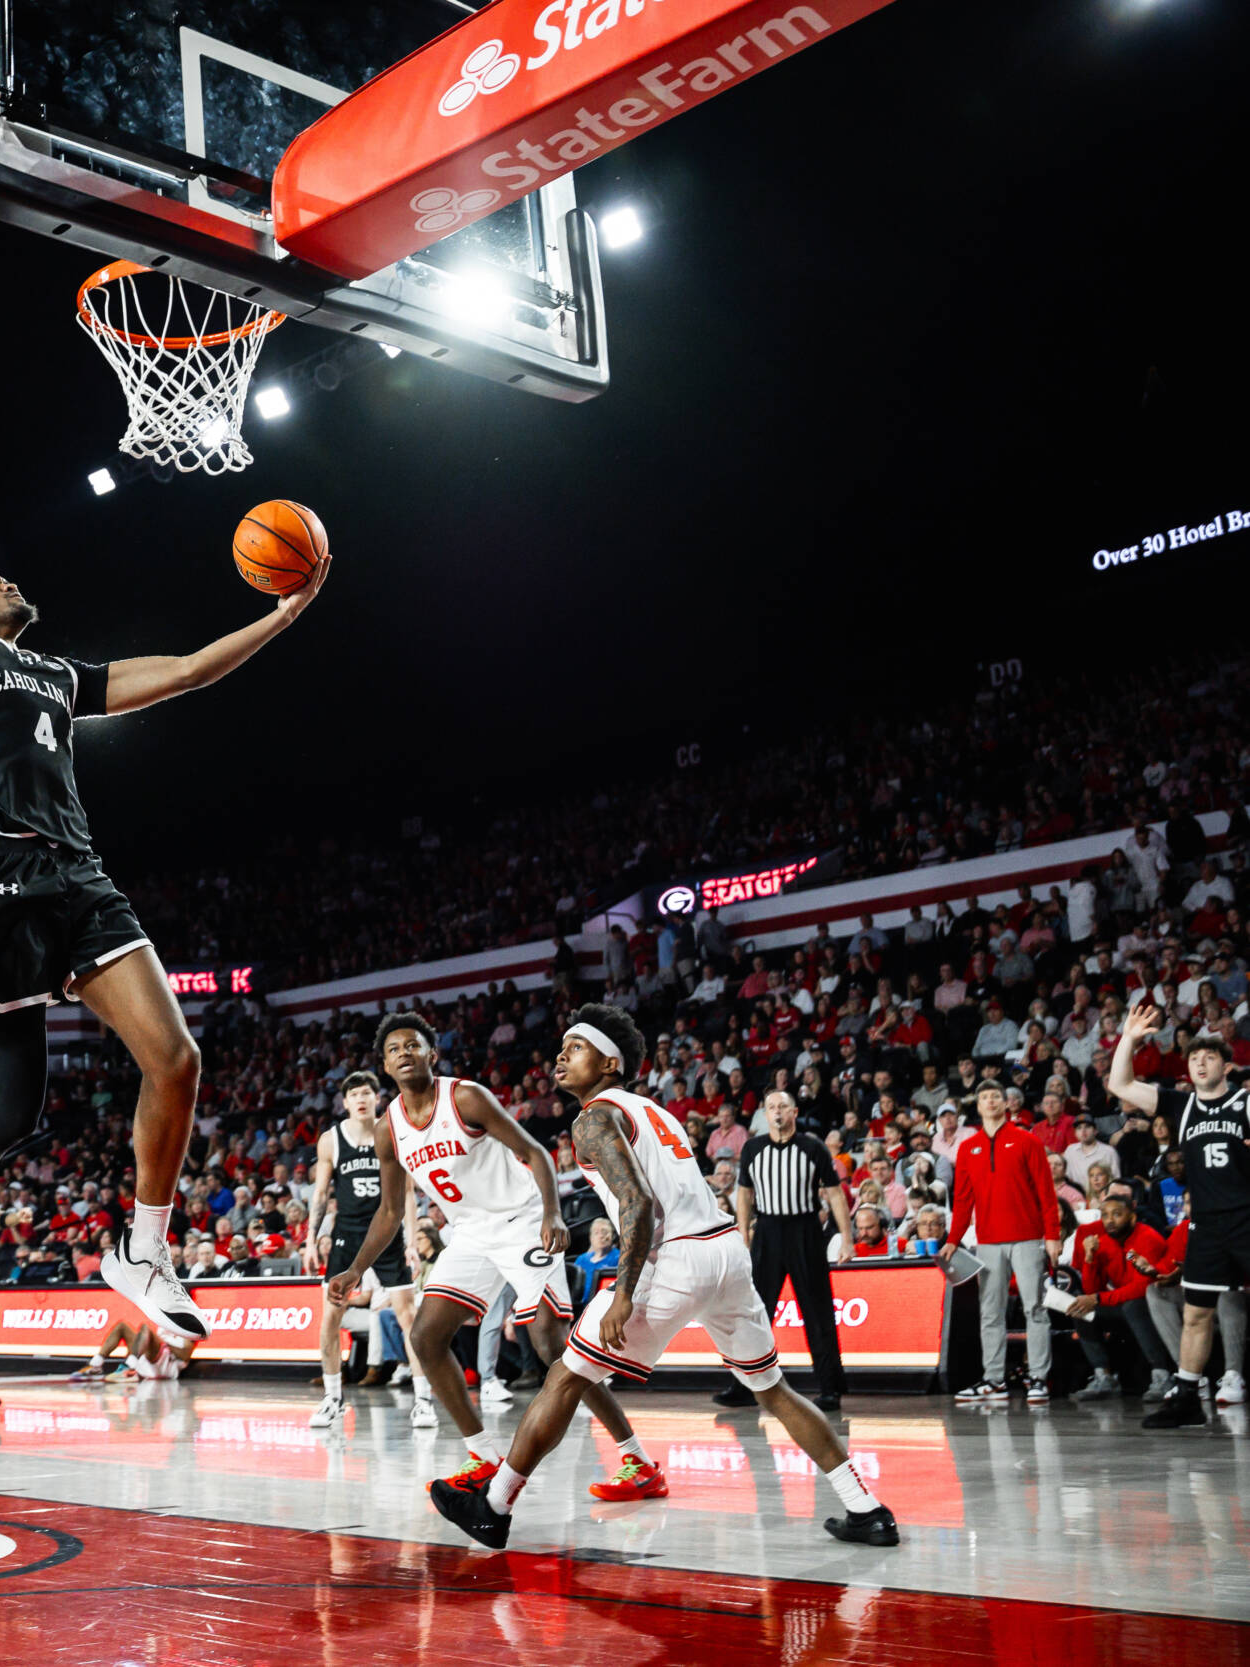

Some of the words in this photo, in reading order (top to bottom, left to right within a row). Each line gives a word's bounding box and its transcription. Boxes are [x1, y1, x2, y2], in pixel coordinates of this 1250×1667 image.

[526, 0, 663, 70] Sta
[481, 5, 832, 191] StateFarm
[1092, 544, 1139, 571] Over
[1141, 533, 1166, 558] 30
[1167, 514, 1225, 550] Hotel
[33, 711, 58, 752] 4
[643, 1105, 694, 1160] 4
[1186, 1120, 1244, 1140] CAROLINA
[406, 1140, 468, 1172] GEORGIA
[1203, 1142, 1229, 1168] 15
[352, 1177, 381, 1197] 55
[428, 1168, 463, 1203] 6
[523, 1247, 553, 1267] G
[2, 1309, 55, 1329] WELLS
[52, 1308, 108, 1330] FARGO
[200, 1308, 244, 1330] ELLS
[244, 1307, 313, 1330] FARGO
[774, 1298, 868, 1327] AGO
